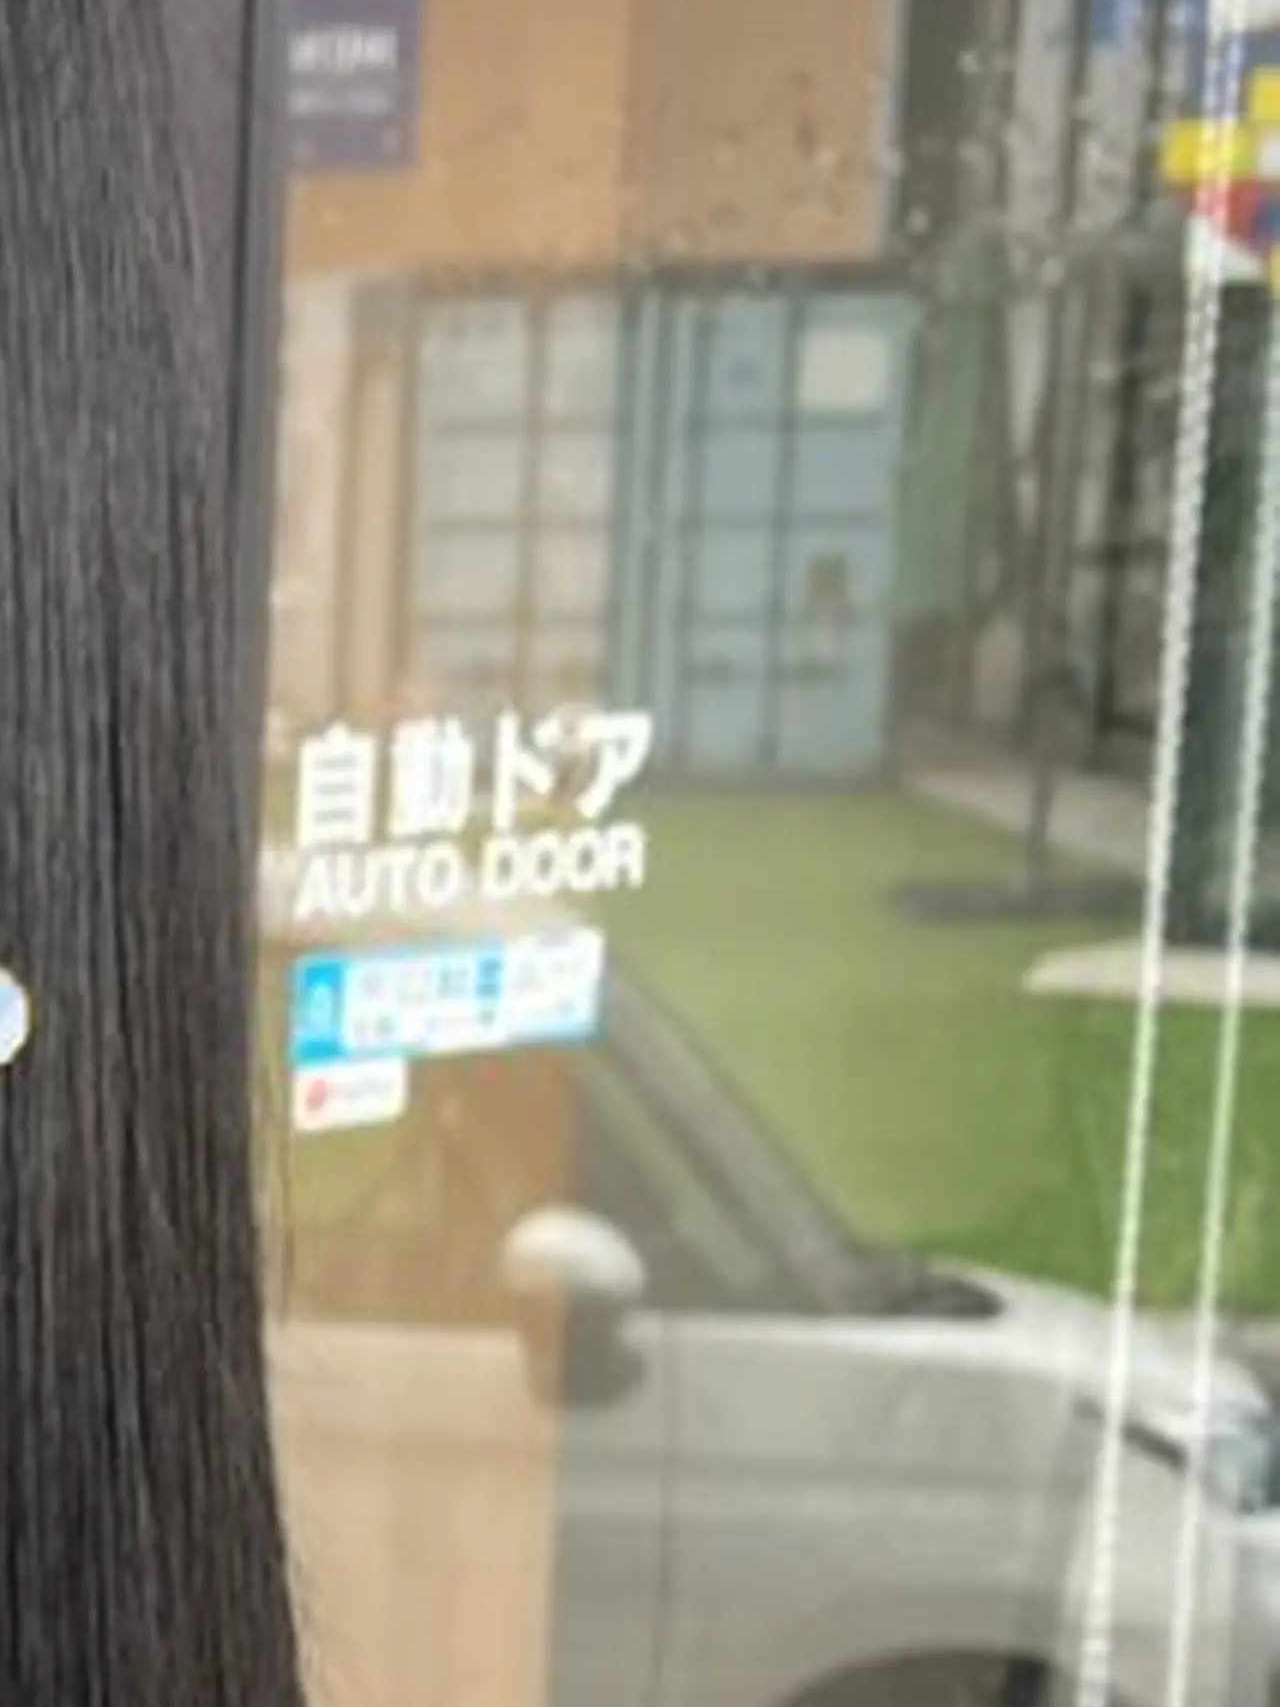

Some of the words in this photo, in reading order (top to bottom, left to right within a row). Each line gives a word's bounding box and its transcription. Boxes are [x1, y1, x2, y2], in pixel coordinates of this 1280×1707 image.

[297, 709, 652, 845] 自動ドア
[293, 843, 464, 920] AUTO
[482, 824, 644, 895] DOOR
